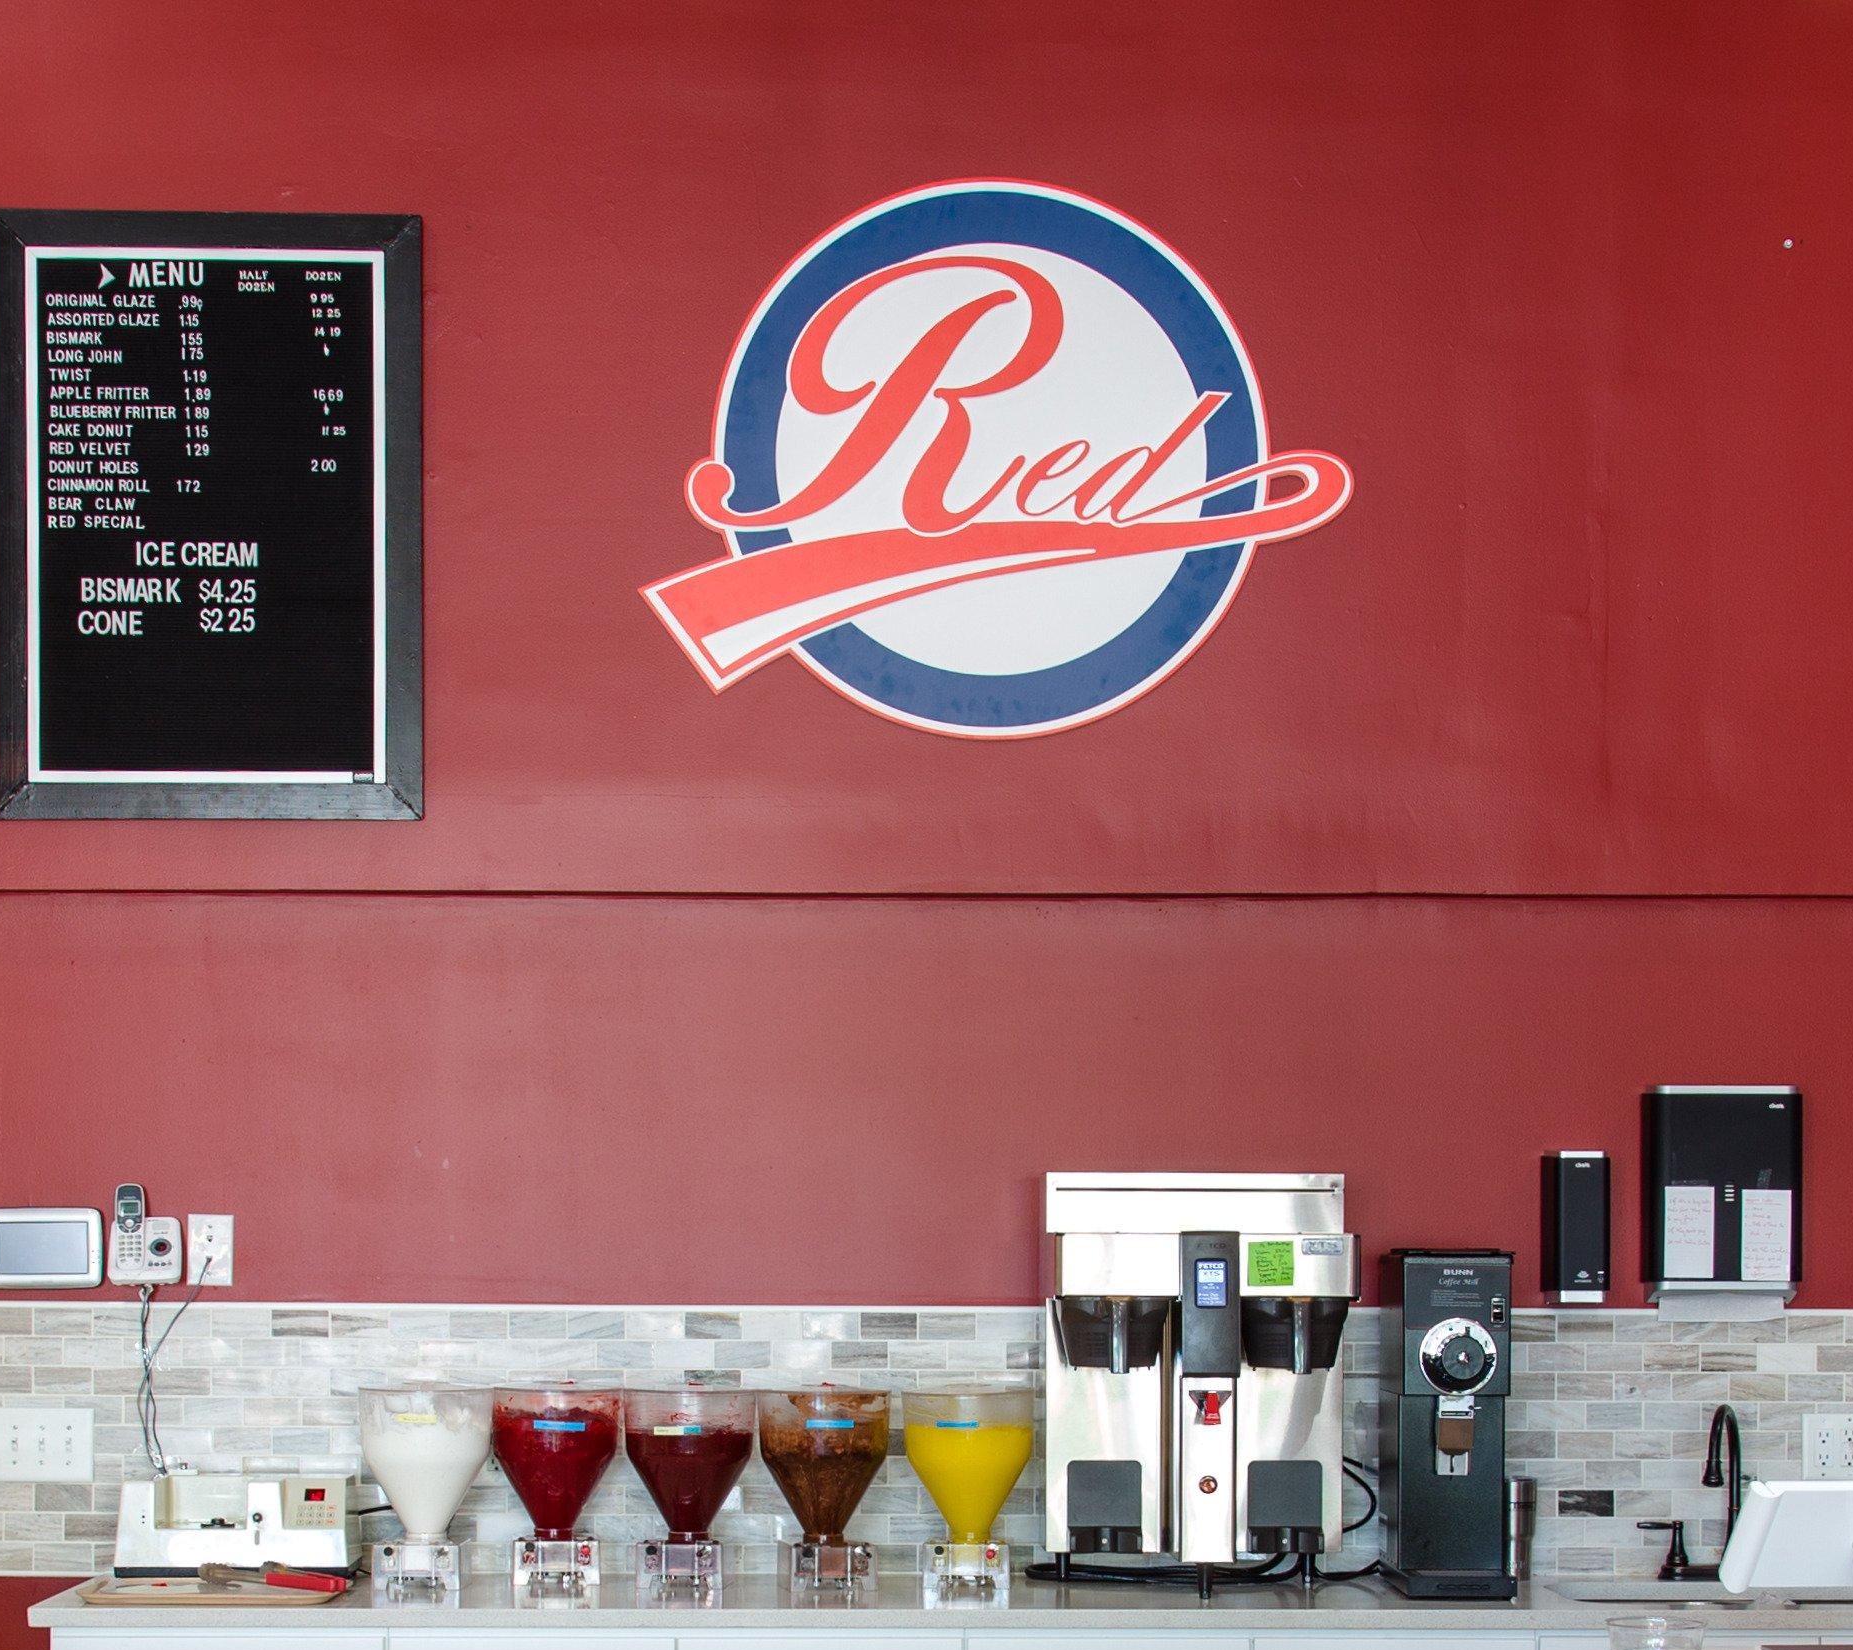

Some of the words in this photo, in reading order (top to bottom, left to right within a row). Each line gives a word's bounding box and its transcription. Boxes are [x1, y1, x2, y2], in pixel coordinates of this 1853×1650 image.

[128, 262, 205, 287] MENU
[238, 270, 269, 280] HALF
[45, 293, 107, 308] ORIGINAL
[112, 294, 157, 308] GLAZE
[47, 312, 115, 327] ASSORTED
[118, 313, 161, 327] GLAZE
[46, 331, 103, 345] BISMARK
[47, 350, 84, 363] LONG
[87, 350, 123, 364] JOHN
[49, 368, 92, 382] TWIST
[49, 386, 92, 400] APPLE
[96, 387, 150, 400] FRITTER
[687, 254, 1233, 536] Red
[49, 405, 122, 419] BLUEBERRY
[124, 406, 177, 419] FRITTER
[48, 423, 81, 437] CAKE
[87, 423, 134, 437] DONUT
[48, 442, 74, 455] RED
[79, 442, 131, 456] VELVET
[48, 460, 94, 474] DONUT
[99, 461, 139, 474] HOLES
[47, 478, 114, 492] CINNAMON
[118, 479, 150, 493] ROLL
[48, 497, 83, 511] BEAR
[95, 498, 136, 511] CLAW
[47, 515, 76, 529] RED
[84, 515, 146, 530] SPECIAL
[135, 541, 175, 567] ICE
[180, 542, 259, 568] CREAM
[80, 577, 182, 604] BISMARK
[198, 578, 257, 604] $4.25
[77, 610, 144, 636] CONE
[1443, 1268, 1474, 1276] BUNN
[1438, 1277, 1462, 1287] Coffee
